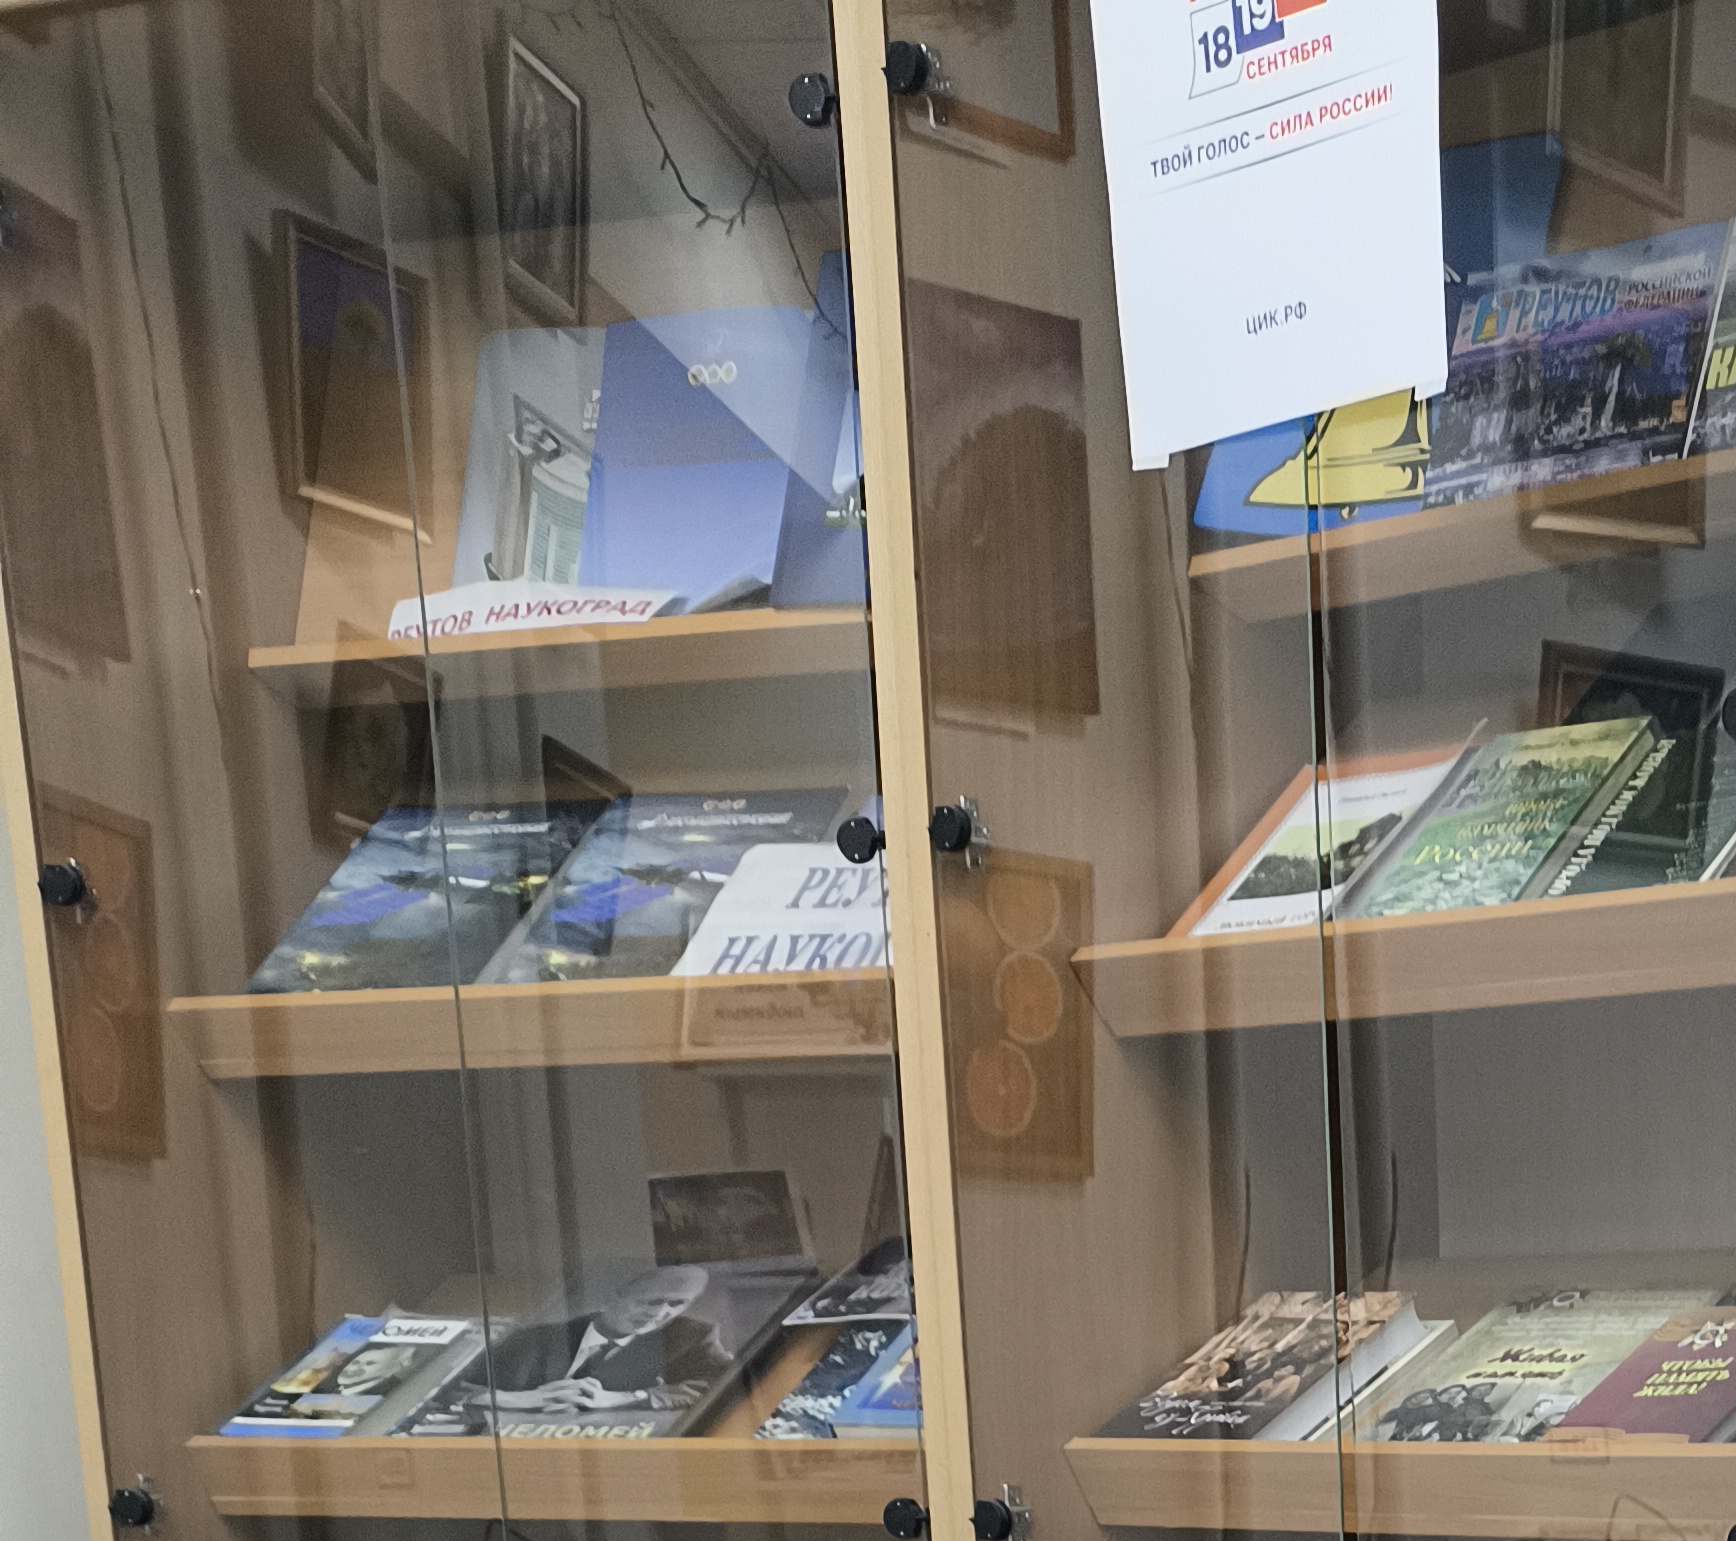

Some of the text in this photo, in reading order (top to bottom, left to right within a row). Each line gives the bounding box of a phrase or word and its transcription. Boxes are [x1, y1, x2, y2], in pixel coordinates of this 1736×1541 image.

[1198, 24, 1233, 73] 18
[1246, 34, 1333, 80] СЕНТЯБРЯ
[1149, 143, 1193, 179] ТВОЙ
[1197, 130, 1251, 164] ГОЛОС
[1269, 110, 1315, 140] СИЛА
[1319, 83, 1393, 124] РОССИИ!
[1246, 300, 1308, 336] ЦИК.РФ
[484, 599, 655, 626] НАУКОГРАД
